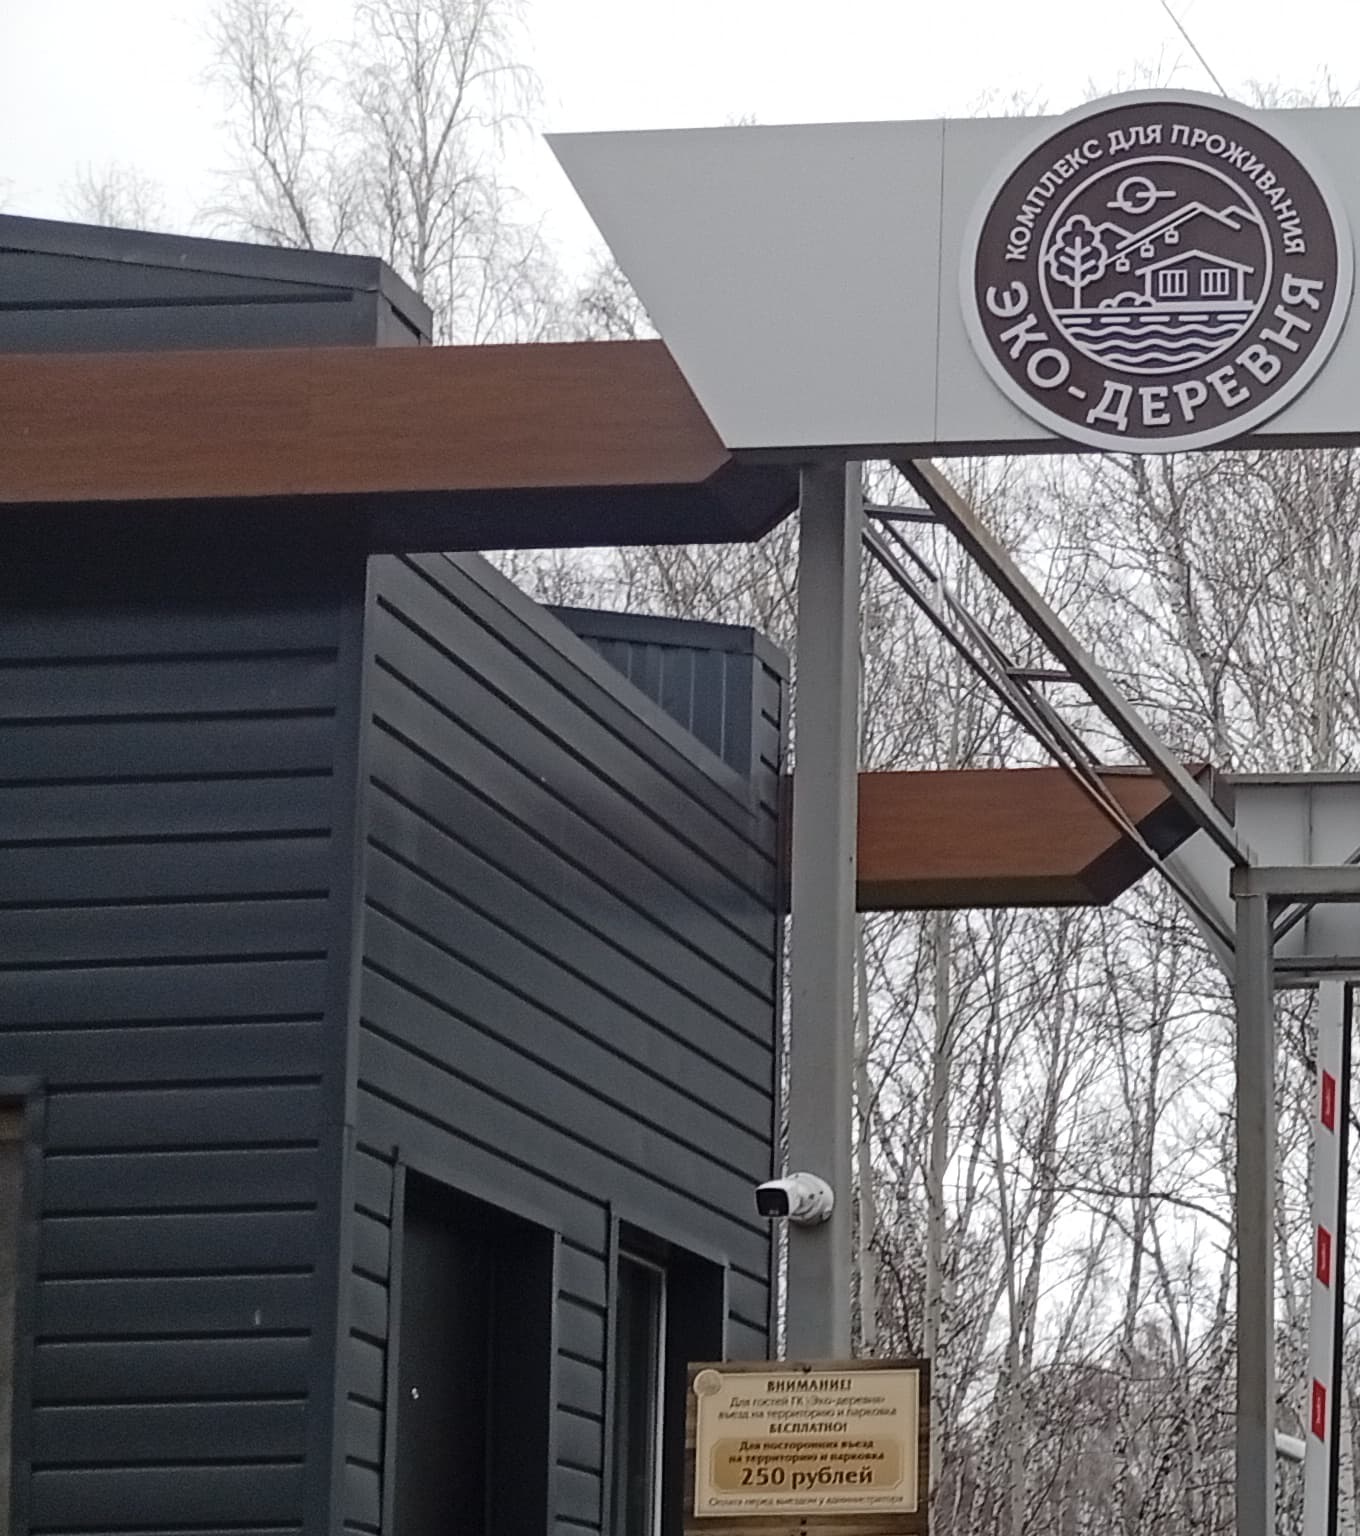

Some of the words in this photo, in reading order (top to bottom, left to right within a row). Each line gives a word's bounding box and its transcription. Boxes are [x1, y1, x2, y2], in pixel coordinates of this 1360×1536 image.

[1005, 139, 1104, 261] КОМПЛЕКС
[1107, 123, 1163, 156] ДЛЯ
[1169, 124, 1307, 256] ПРОЖИВАНИЯ
[985, 272, 1325, 432] ЭКО-ДЕРЕВНЯ
[766, 1379, 852, 1394] ВНИМАНИЕ!
[769, 1422, 848, 1434] БЕСПЛАТНО!
[738, 1440, 761, 1452] Для
[741, 1466, 785, 1486] 250
[791, 1465, 873, 1491] рублей
